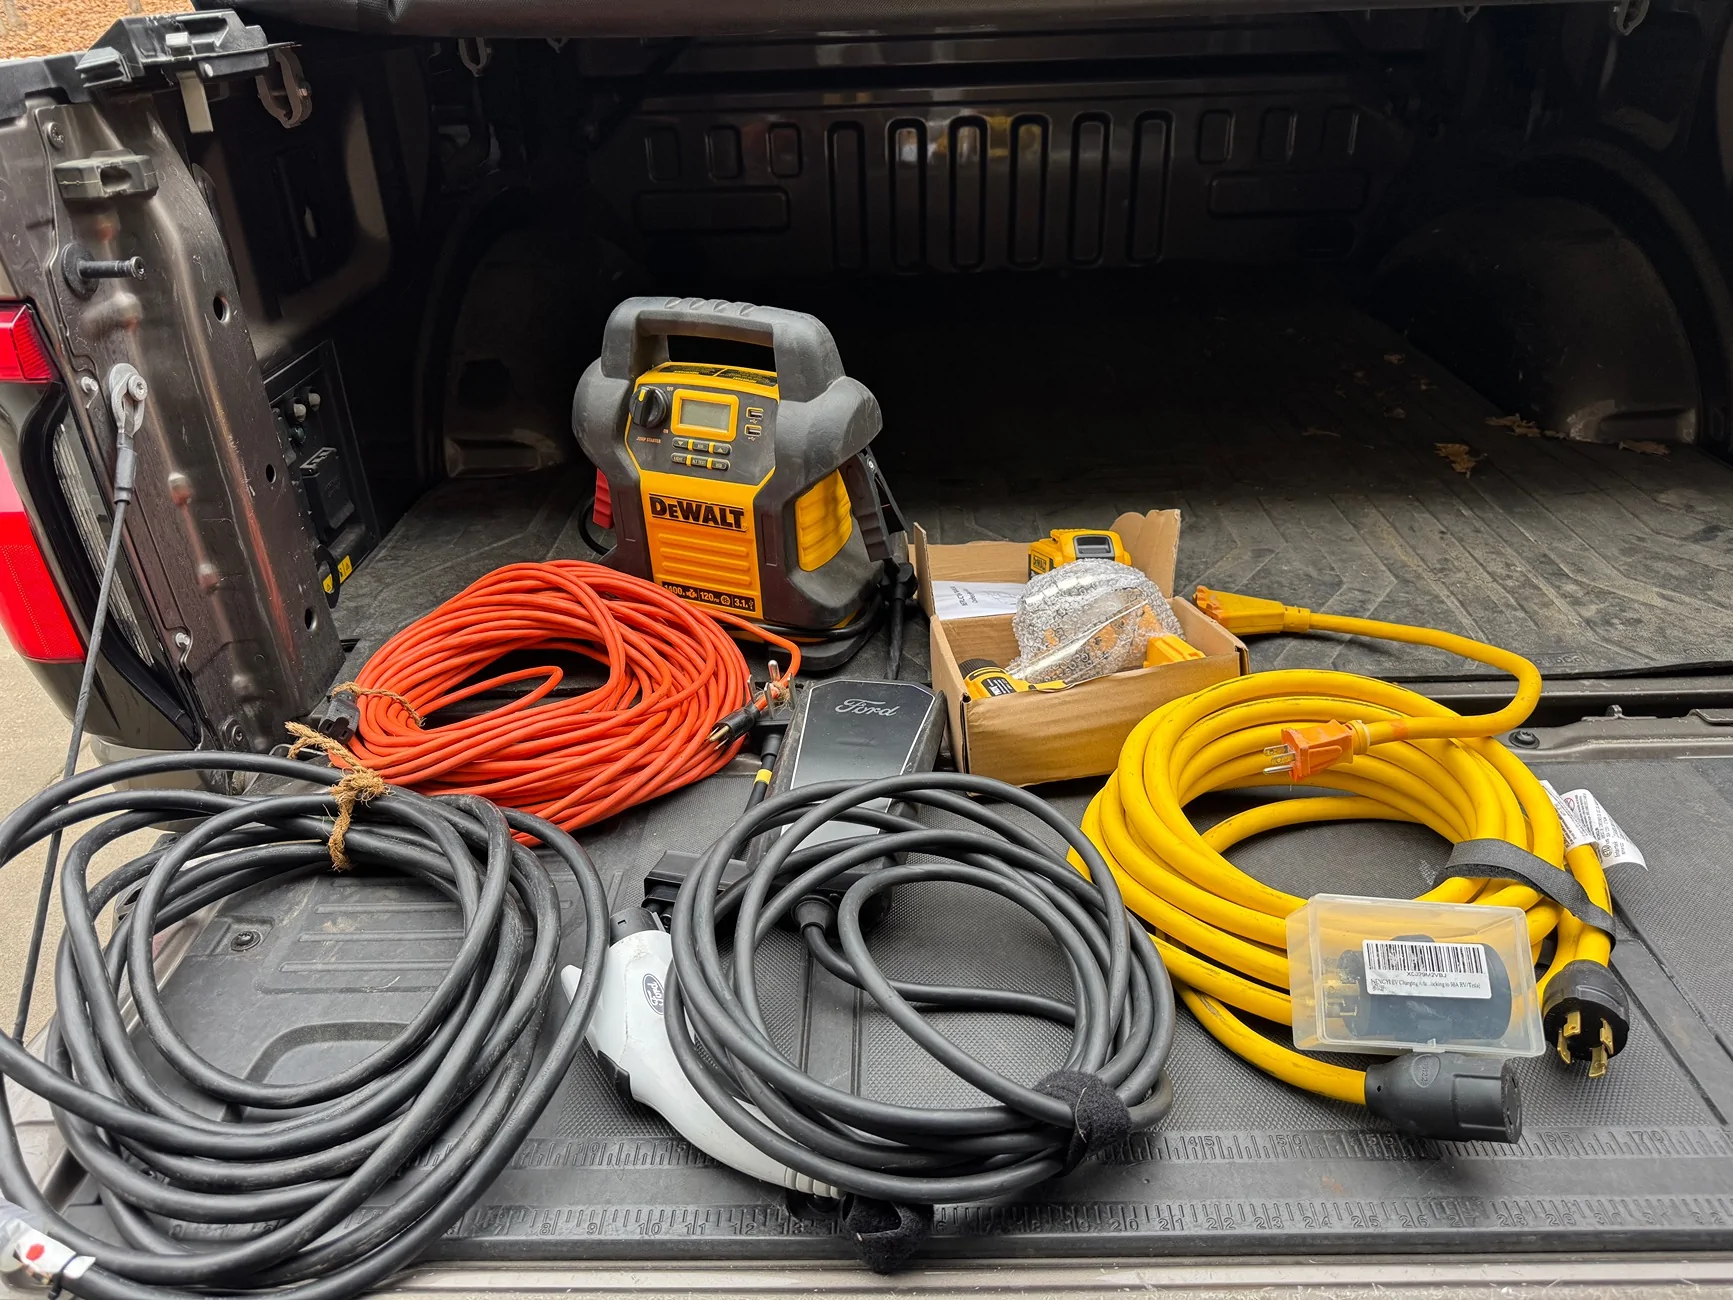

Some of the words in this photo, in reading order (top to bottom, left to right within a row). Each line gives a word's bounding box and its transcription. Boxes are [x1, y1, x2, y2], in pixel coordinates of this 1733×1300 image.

[834, 698, 900, 717] Ford
[646, 982, 664, 1006] Ford
[1157, 1217, 1185, 1231] 21
[1205, 1217, 1237, 1231] 22
[1253, 1216, 1285, 1230] 23
[1302, 1215, 1333, 1230] 24
[1350, 1214, 1382, 1229] 25
[1398, 1214, 1431, 1228] 26
[1496, 1213, 1528, 1227] 28
[1544, 1212, 1577, 1227] 29
